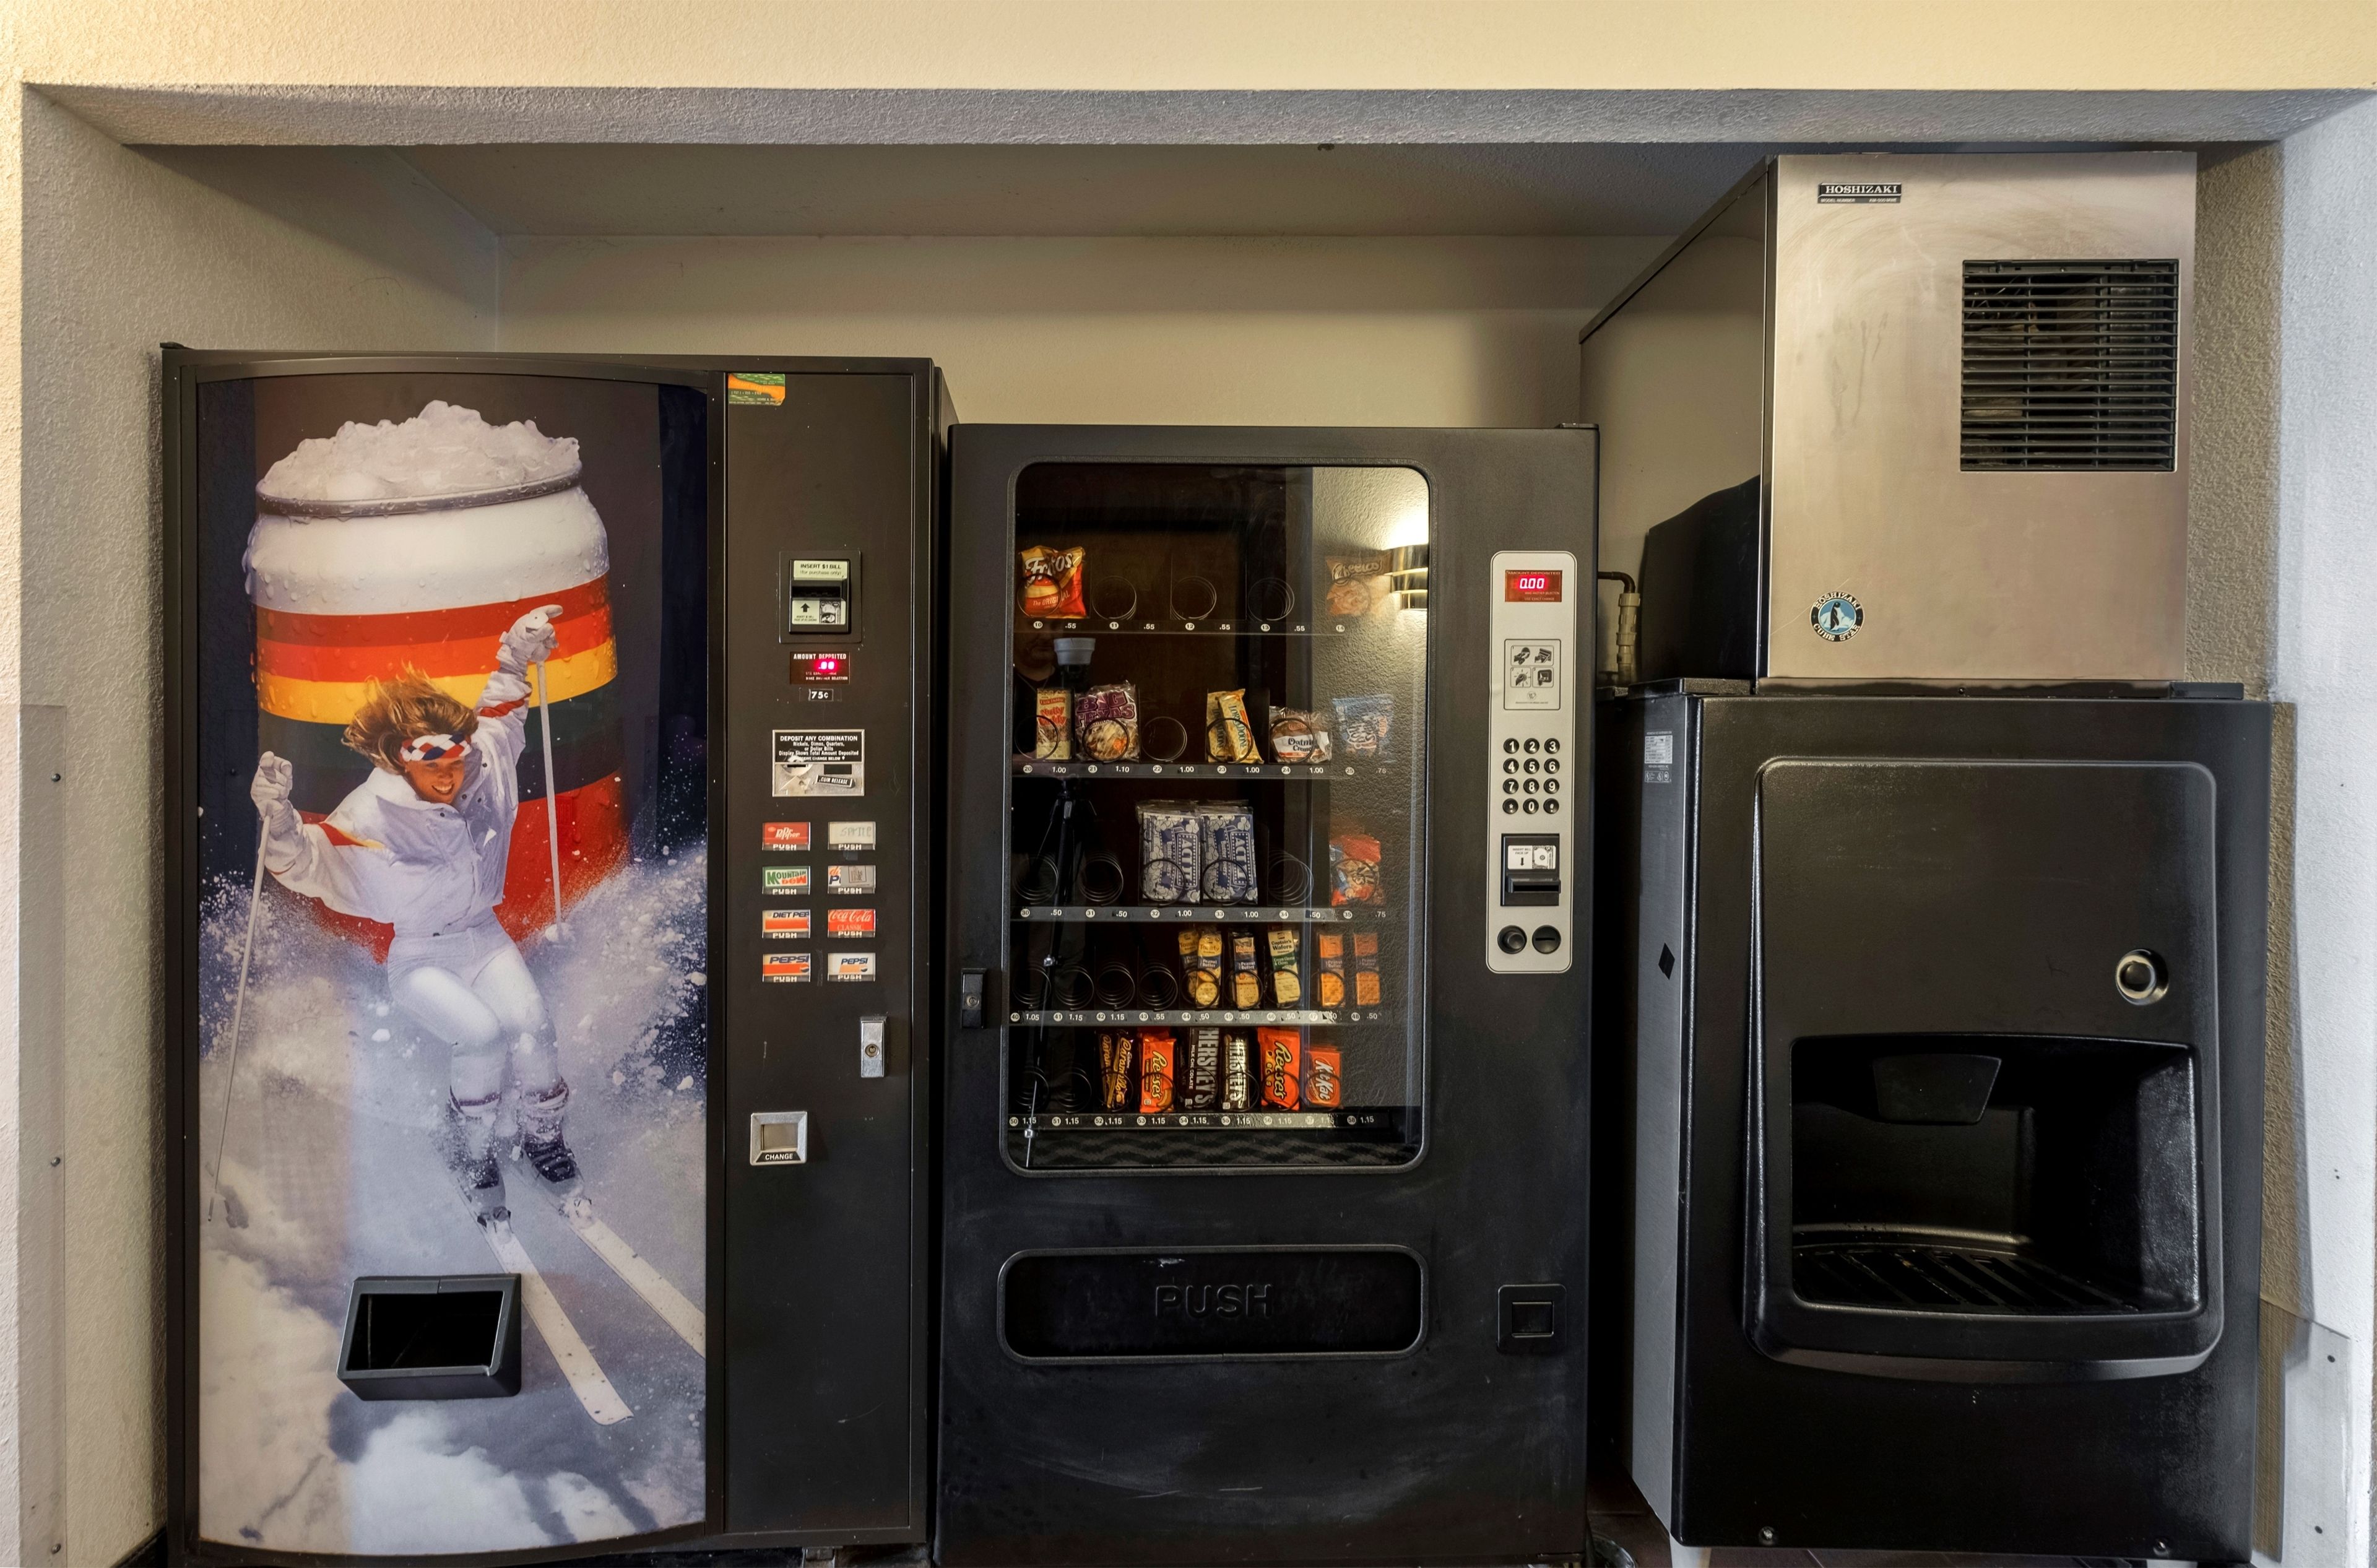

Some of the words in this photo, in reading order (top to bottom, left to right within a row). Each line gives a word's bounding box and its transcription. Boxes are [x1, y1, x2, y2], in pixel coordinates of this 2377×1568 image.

[1825, 185, 1898, 194] HOSHIZAKI
[811, 691, 829, 700] 75¢
[1509, 741, 1515, 752] 1
[1529, 741, 1536, 752] 2
[1549, 741, 1556, 752] 3
[1508, 761, 1515, 772] 4
[1529, 761, 1535, 771] 5
[1549, 761, 1556, 771] 6
[831, 777, 847, 785] RELEASE
[1509, 781, 1515, 792] 7
[1528, 781, 1535, 792] 8
[1549, 781, 1556, 791] 9
[1528, 802, 1535, 812] 0
[1181, 839, 1193, 865] ACT
[1235, 837, 1246, 861] ACT
[769, 955, 809, 964] PEPSI
[841, 957, 868, 965] PEPSI
[1199, 1013, 1210, 1021] .50
[1195, 1030, 1219, 1104] HERSHEY'S
[1273, 1041, 1292, 1099] Reese's
[1151, 1050, 1167, 1099] Reese's
[1155, 1283, 1274, 1319] PUSH
